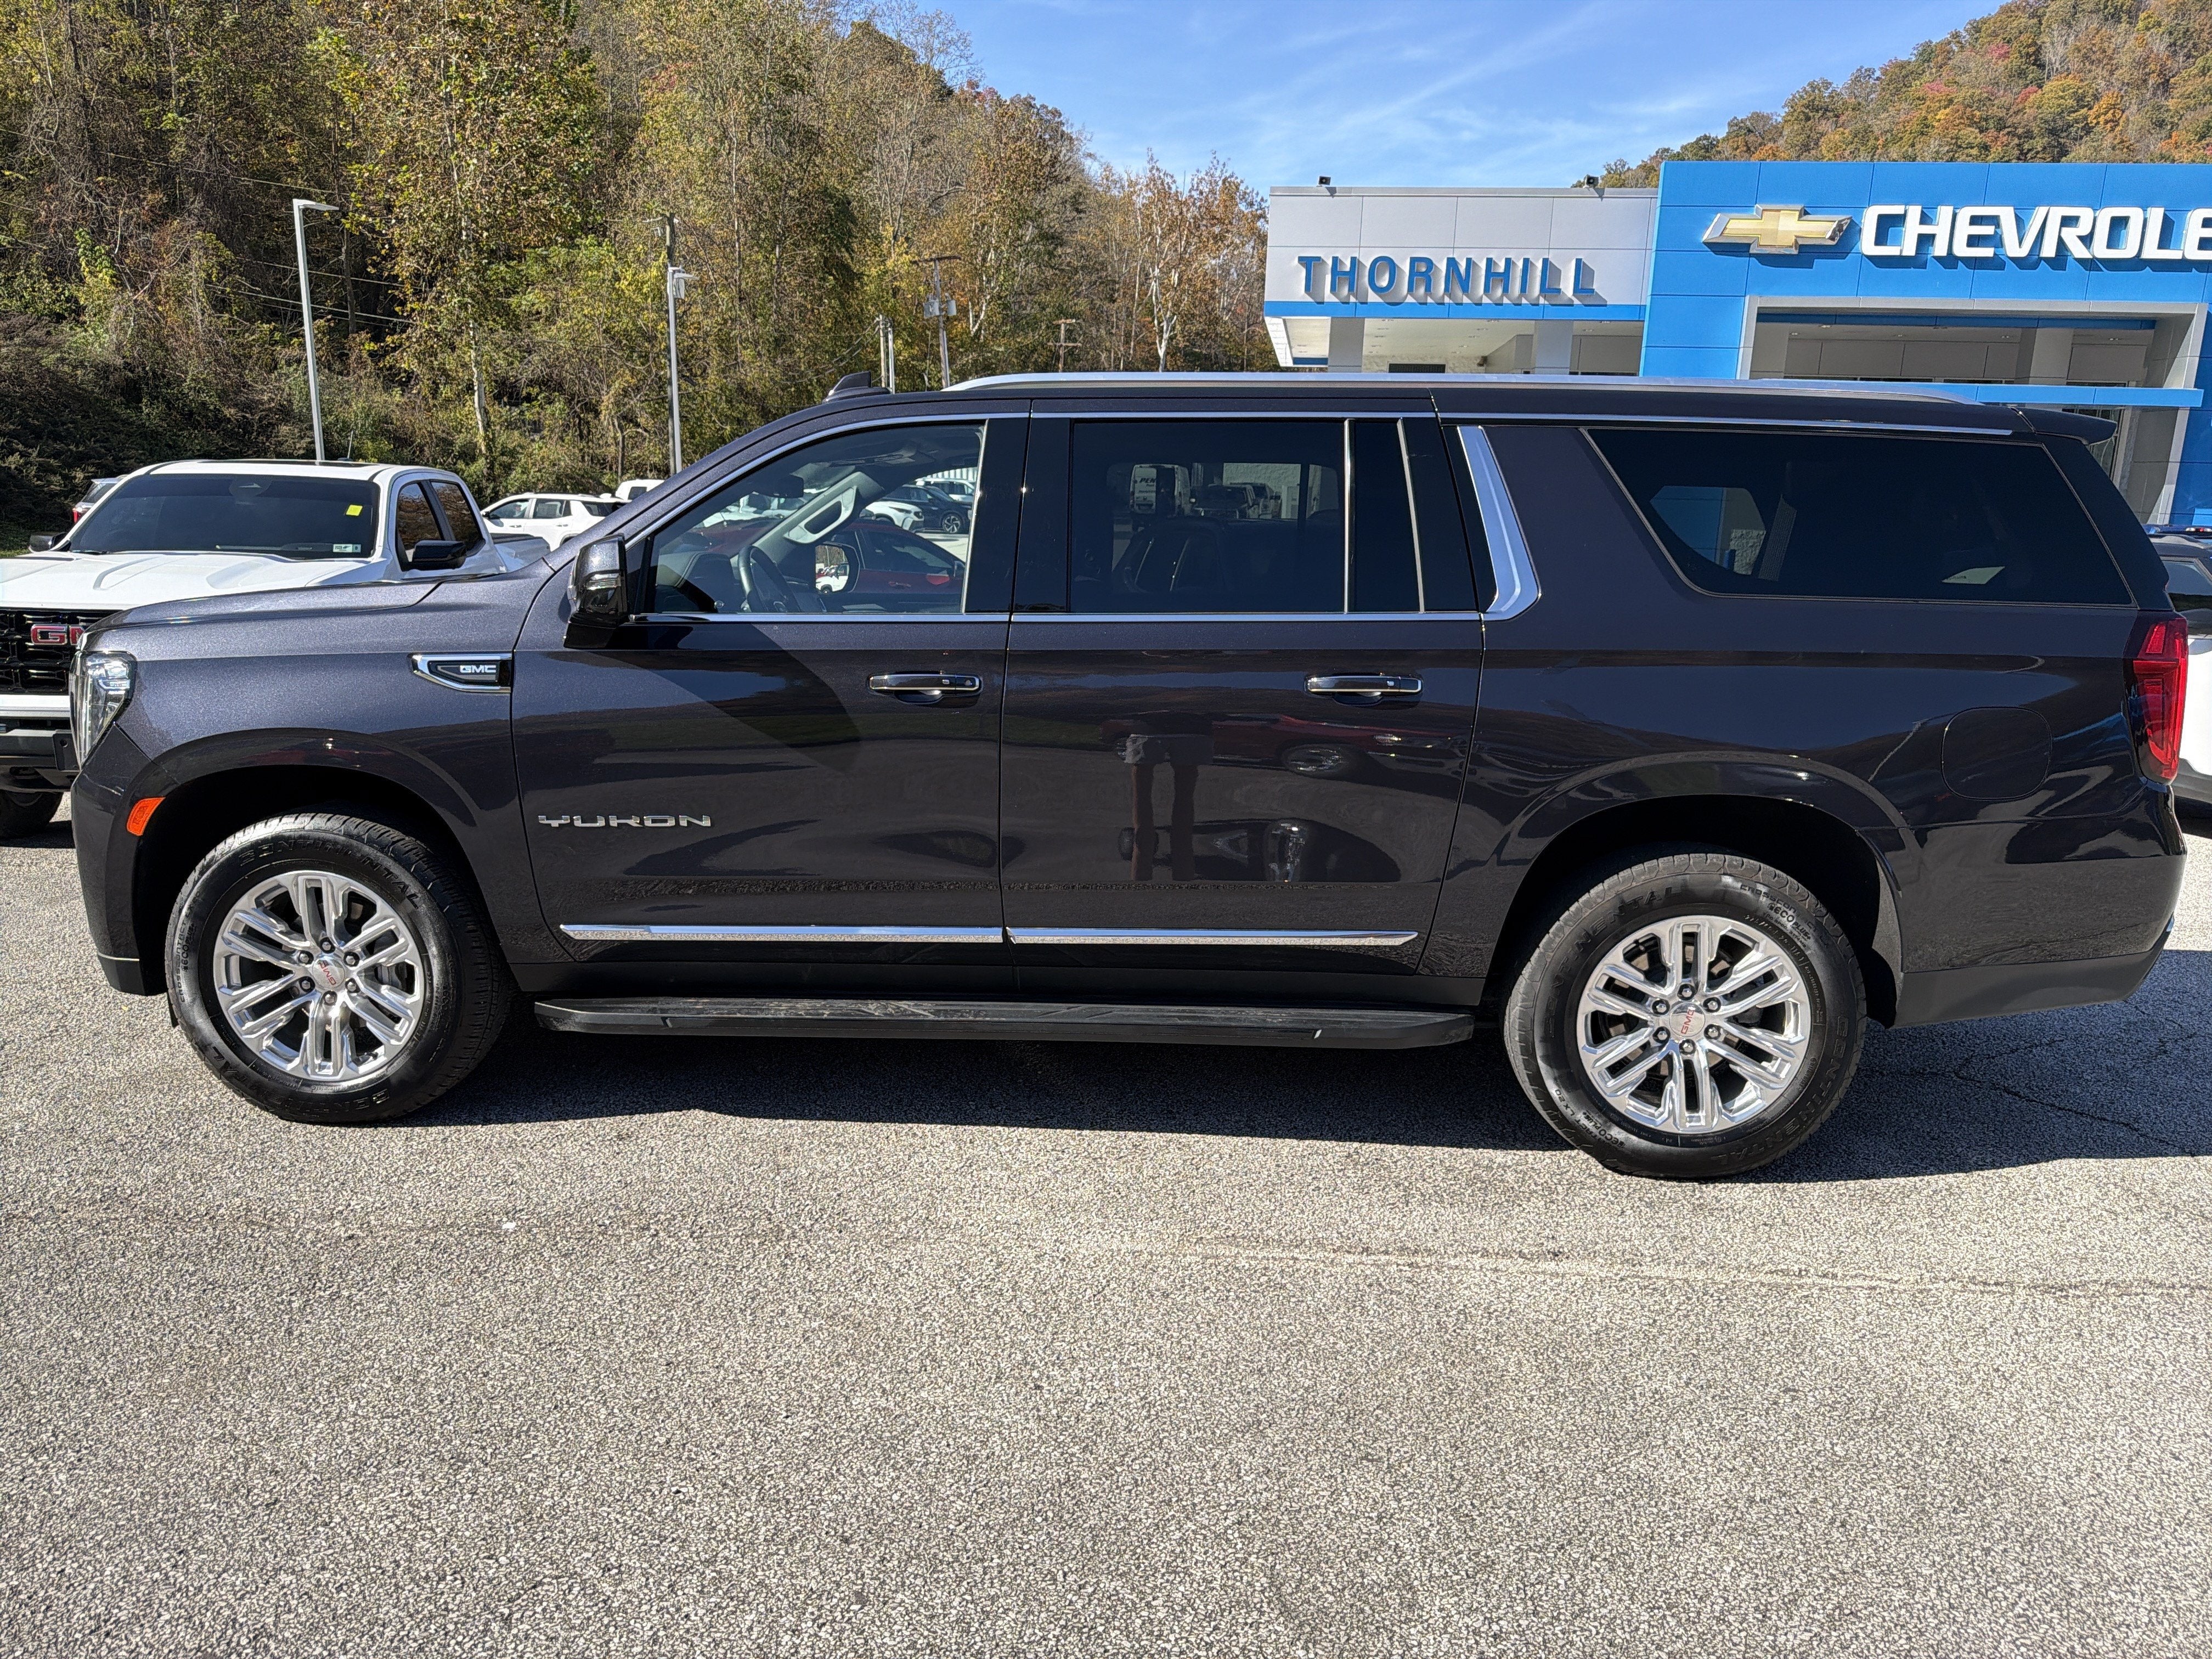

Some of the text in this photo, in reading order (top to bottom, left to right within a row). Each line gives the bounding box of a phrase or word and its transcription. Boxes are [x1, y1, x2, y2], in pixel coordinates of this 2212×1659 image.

[1860, 205, 2212, 260] CHEVROLE
[1297, 256, 1596, 295] THORNHILL
[460, 665, 496, 673] GMC
[538, 815, 711, 827] YUKON
